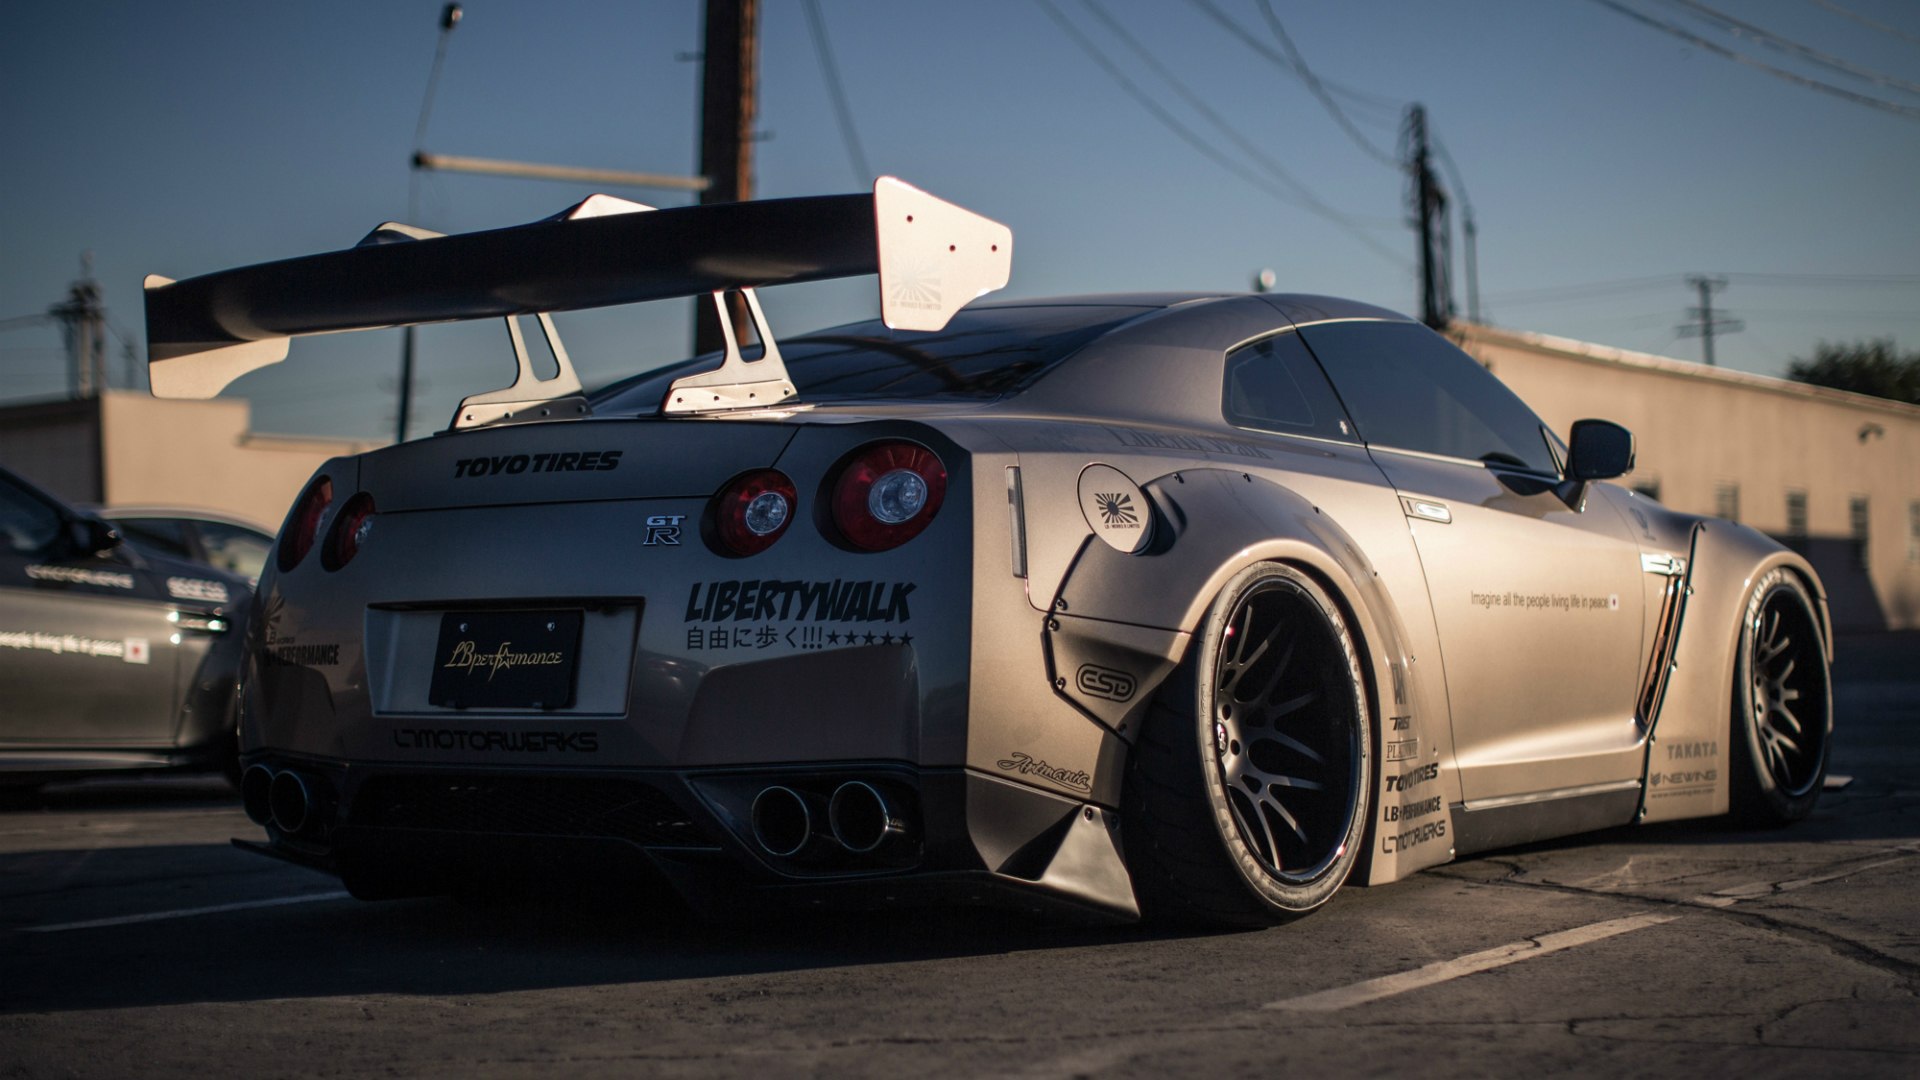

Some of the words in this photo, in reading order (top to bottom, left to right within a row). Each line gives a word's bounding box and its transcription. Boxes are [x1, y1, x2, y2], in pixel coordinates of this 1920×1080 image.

[646, 515, 686, 526] GT
[642, 525, 681, 546] R
[1470, 591, 1501, 609] Imagine
[1503, 592, 1512, 606] all
[1513, 593, 1525, 607] the
[1526, 593, 1550, 611] people
[1551, 594, 1569, 611] living
[1589, 597, 1609, 611] peace
[1667, 741, 1719, 761] TAKATA
